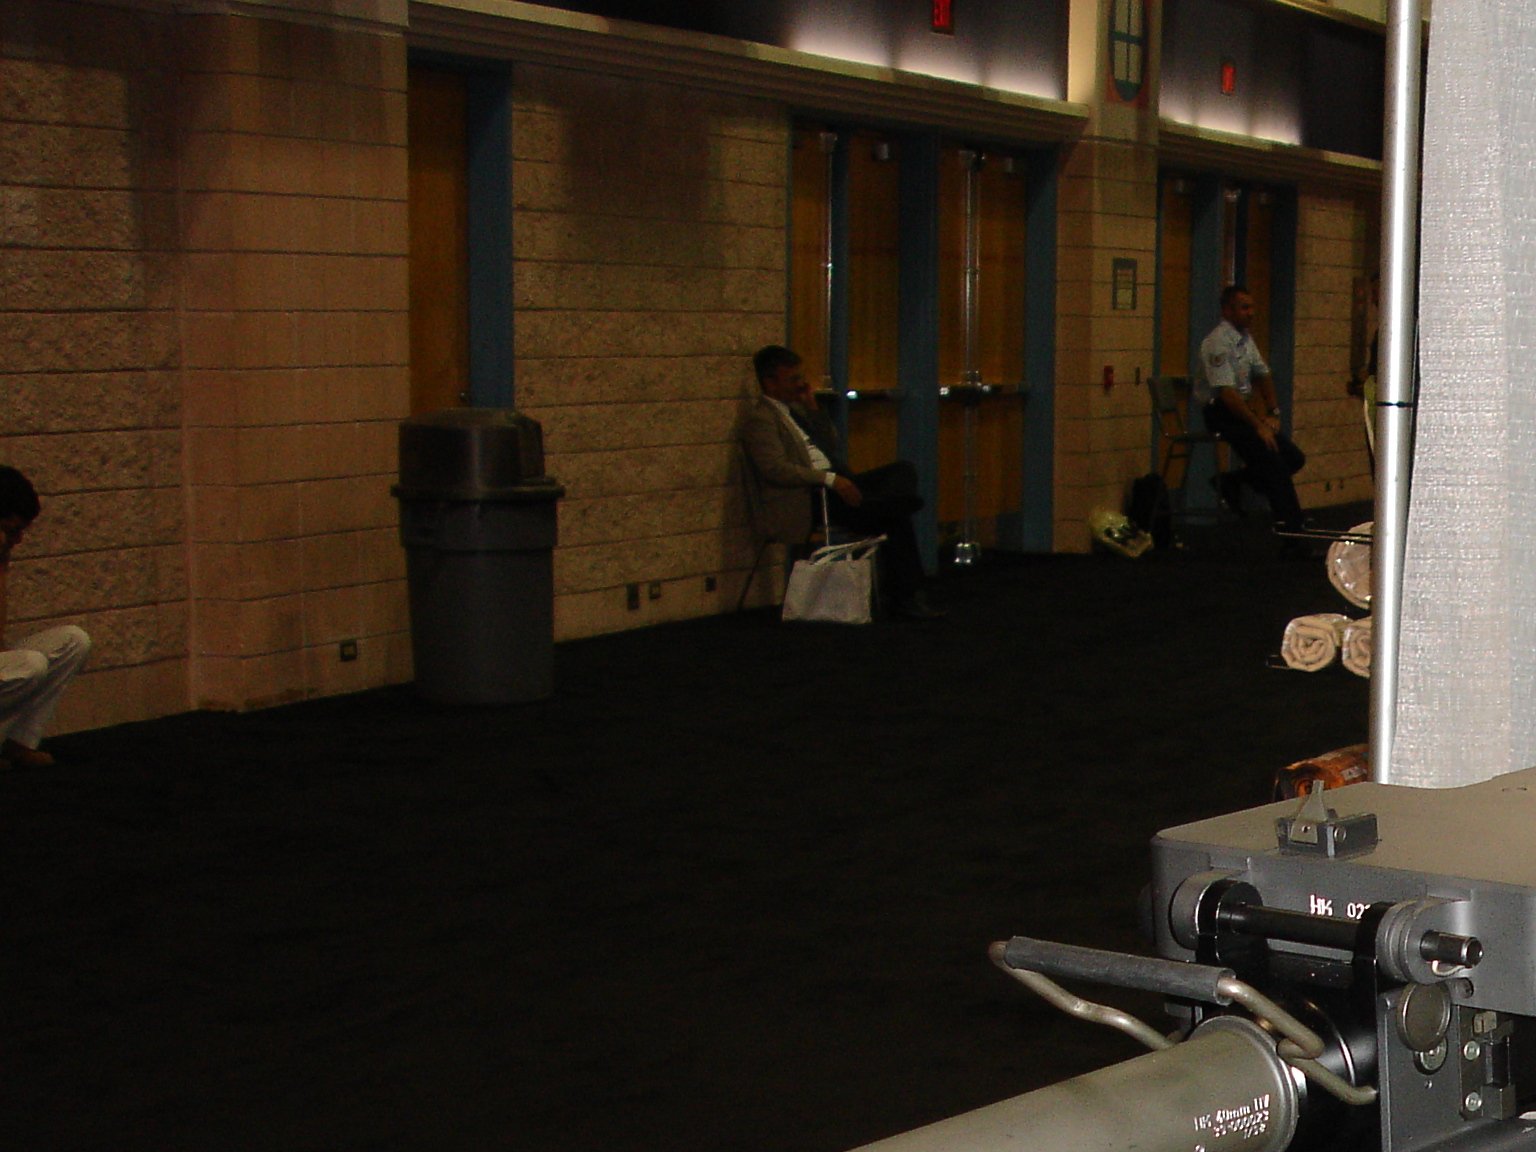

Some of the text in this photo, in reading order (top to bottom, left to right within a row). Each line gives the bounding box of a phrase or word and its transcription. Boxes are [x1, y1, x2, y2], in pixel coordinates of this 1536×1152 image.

[1311, 894, 1371, 920] HK 02
[1216, 1106, 1251, 1124] 40mm
